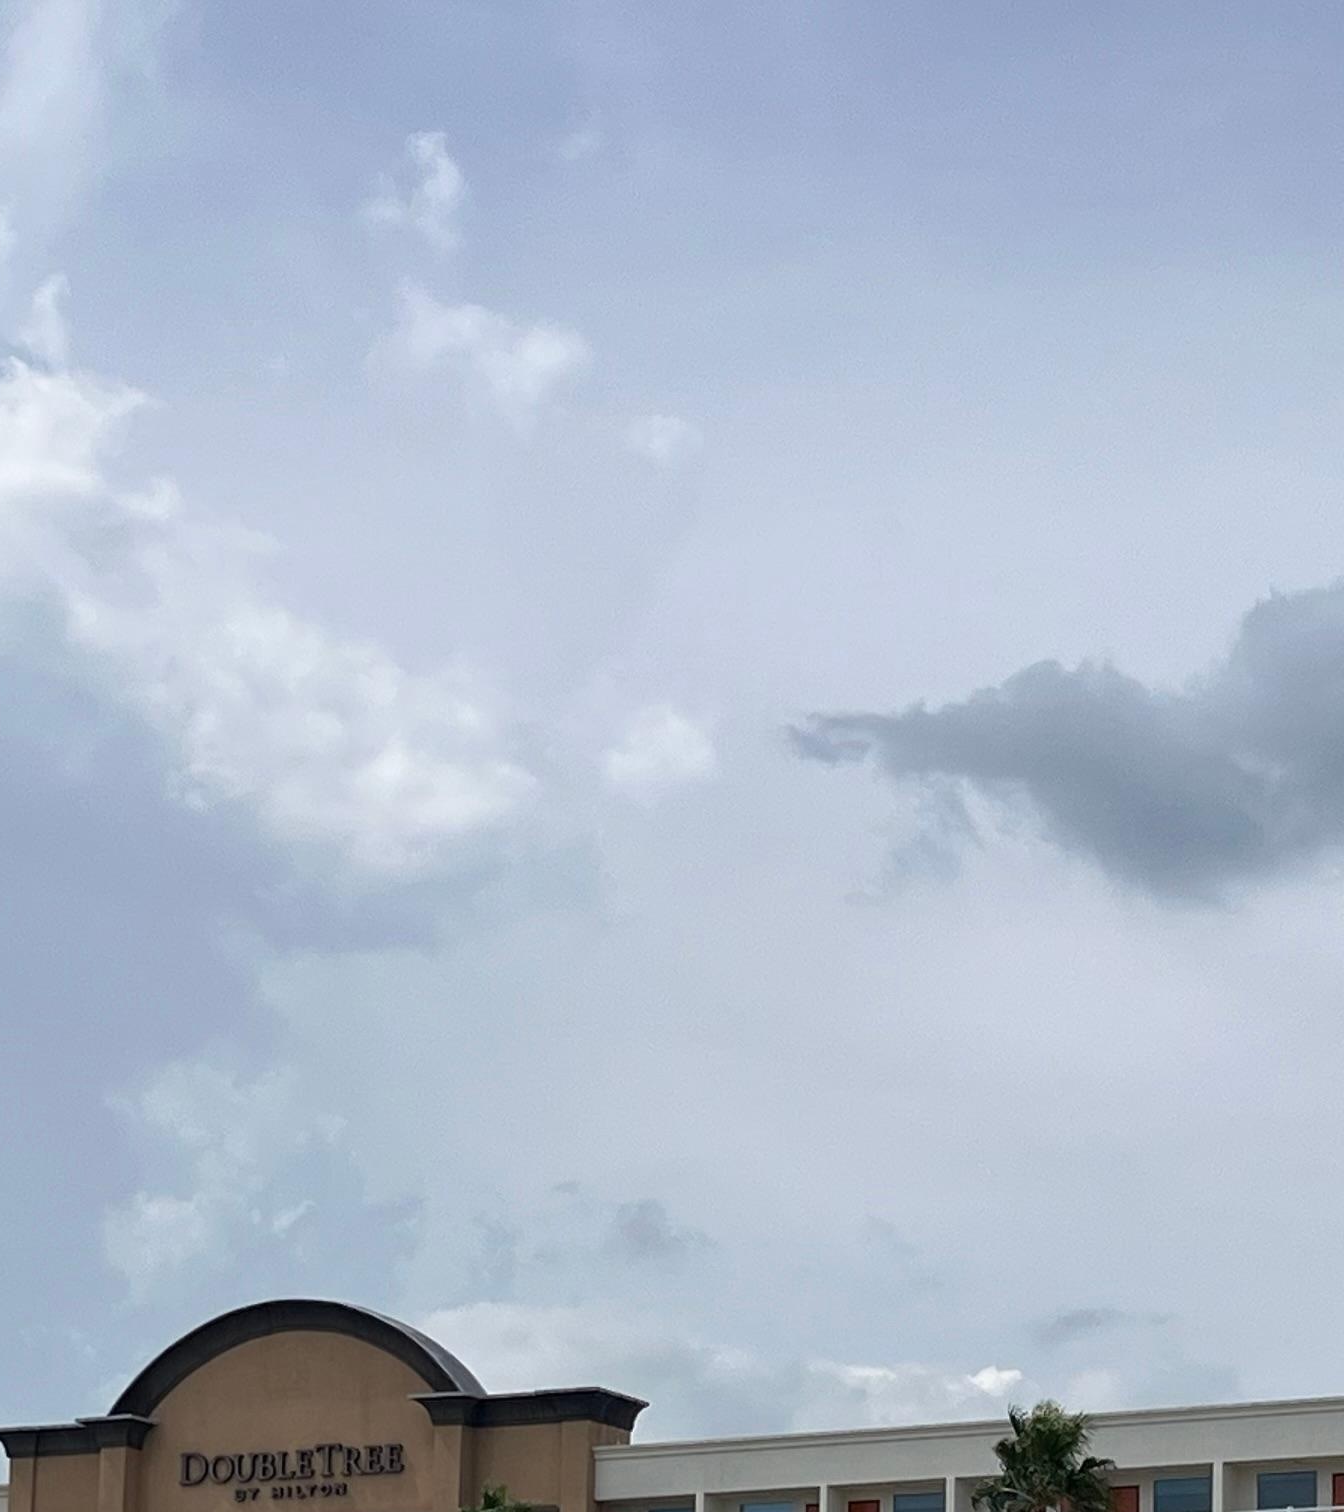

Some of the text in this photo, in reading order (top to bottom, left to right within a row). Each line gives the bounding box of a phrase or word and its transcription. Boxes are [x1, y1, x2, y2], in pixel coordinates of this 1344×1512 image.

[179, 1443, 405, 1487] DOUBLETREE
[234, 1483, 348, 1502] BY HILTON
